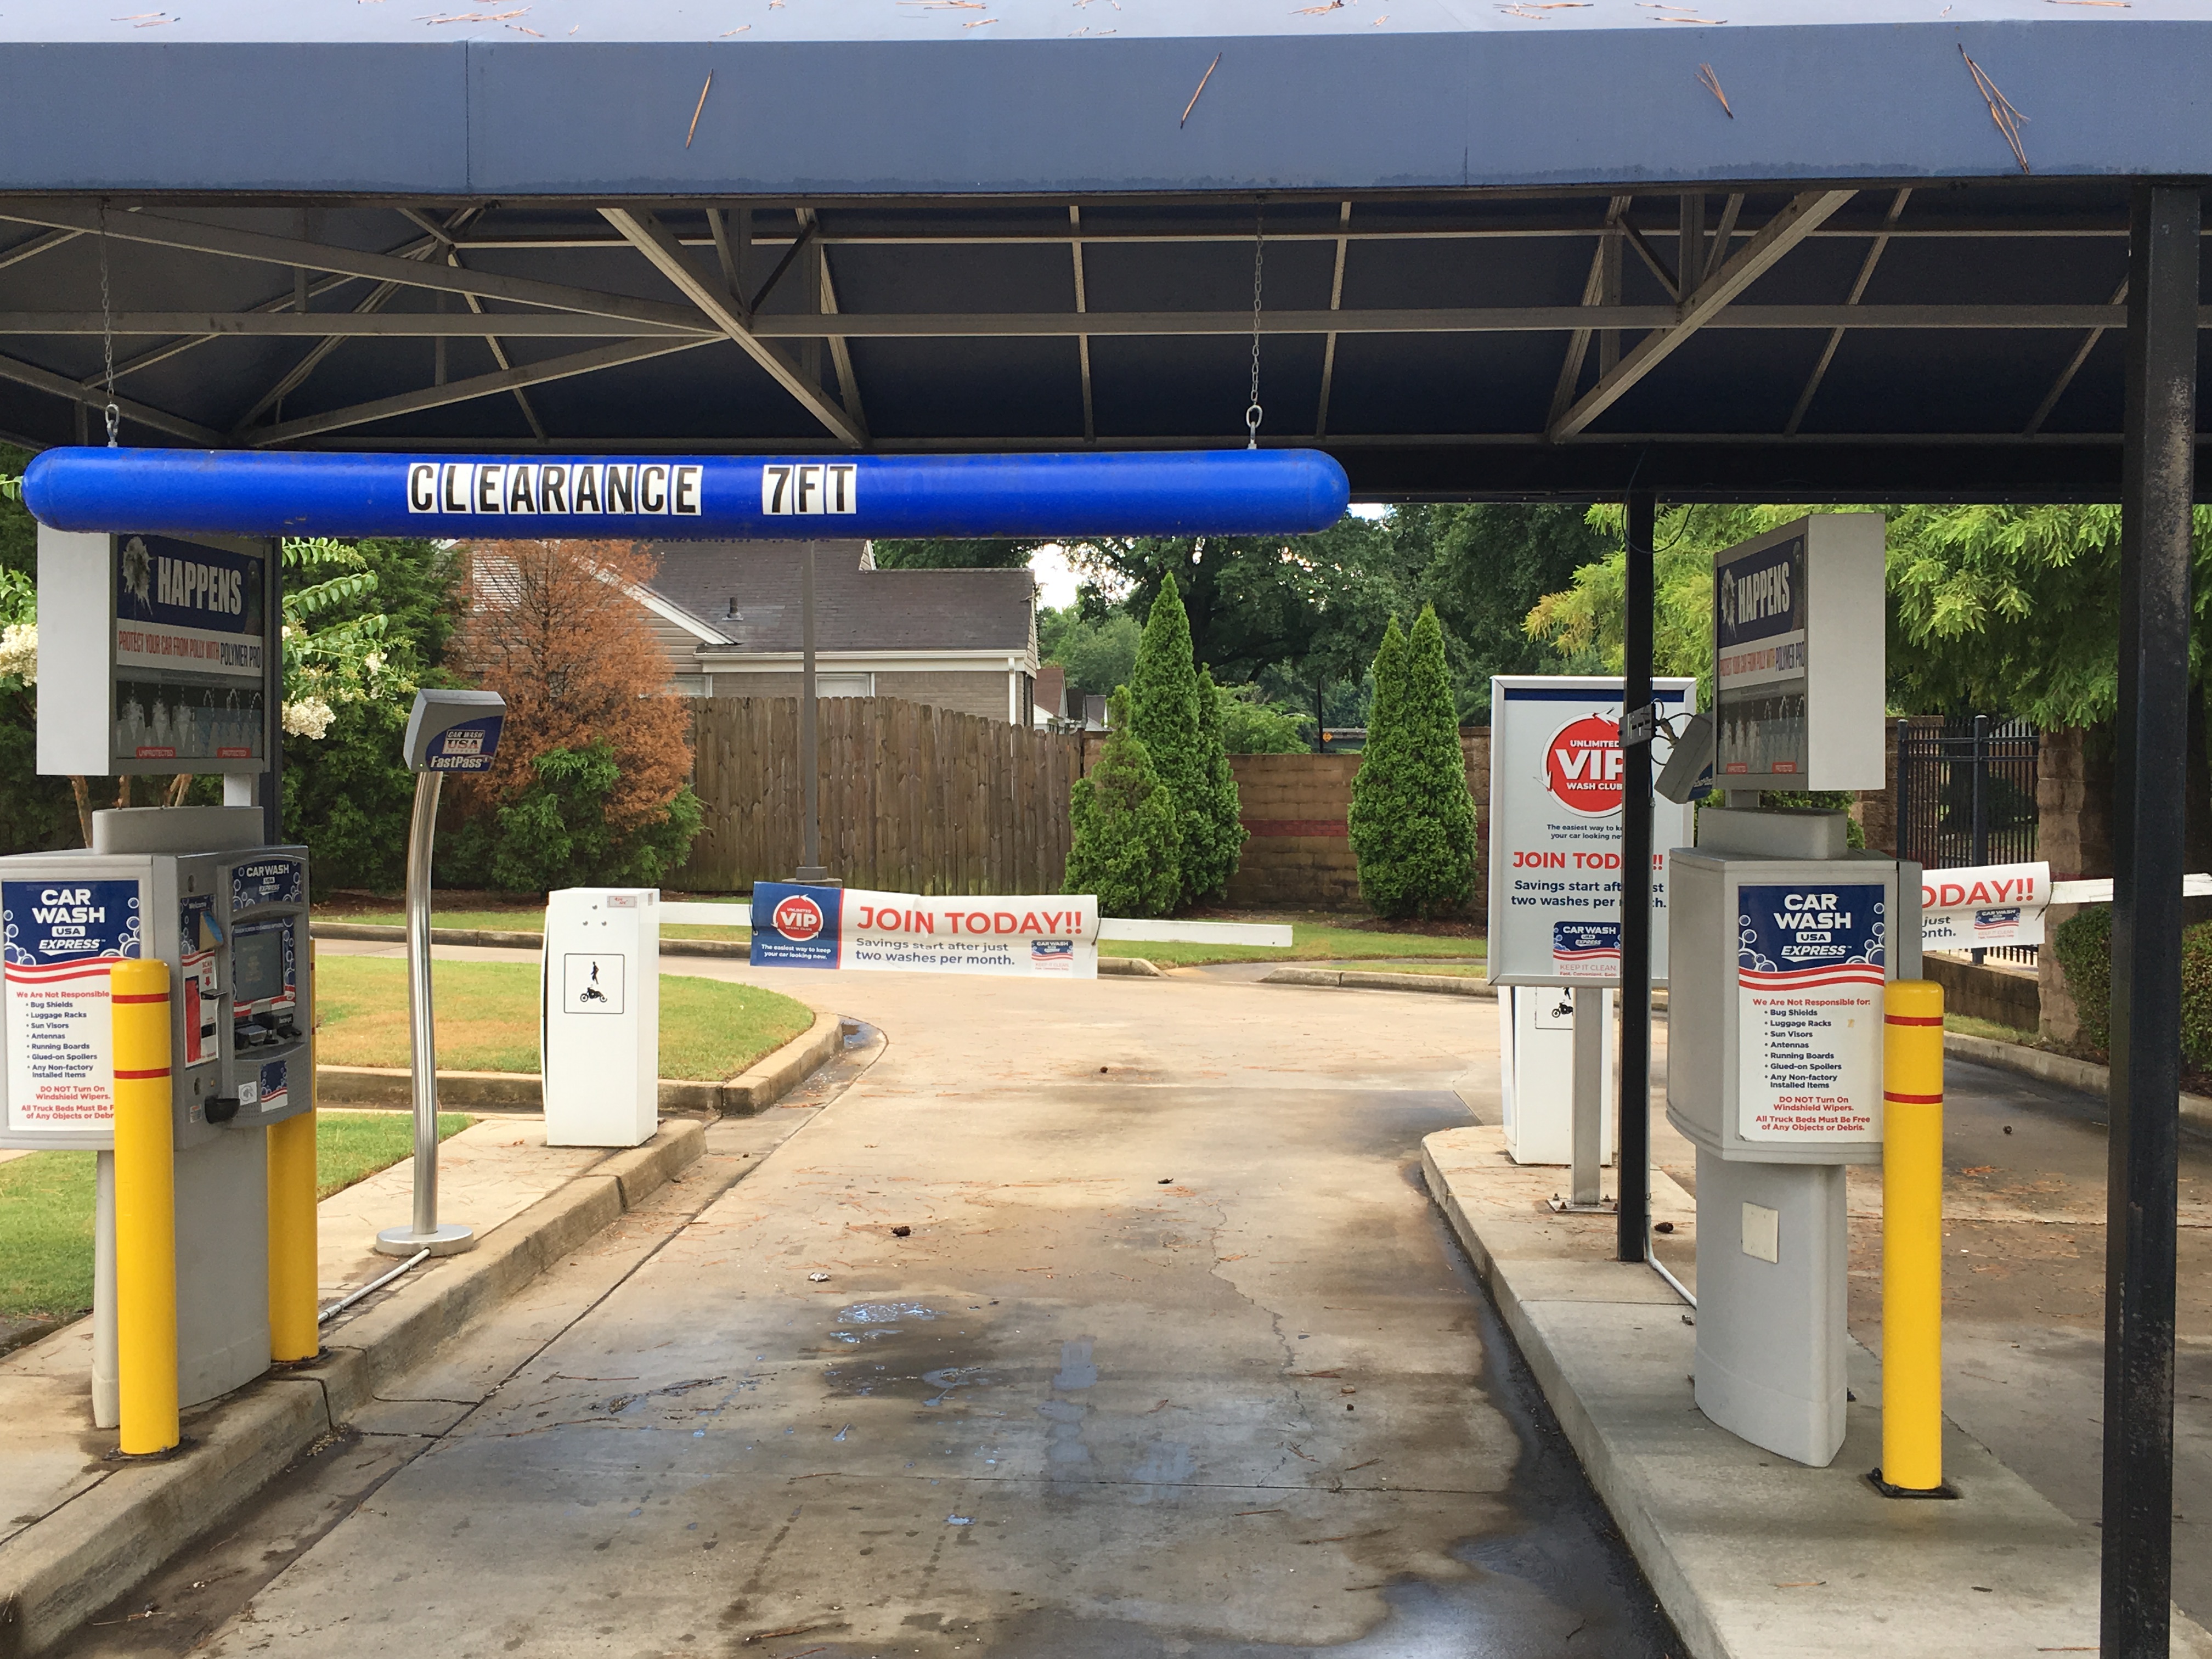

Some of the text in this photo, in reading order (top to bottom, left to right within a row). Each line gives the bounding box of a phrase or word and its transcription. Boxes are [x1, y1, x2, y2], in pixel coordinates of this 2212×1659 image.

[411, 465, 697, 513] CLEARANCE
[158, 556, 241, 615] HAPPENS
[1738, 562, 1790, 624] HAPPENS
[119, 630, 261, 668] PROTECT YOUR CAR FROM POLLY WITH POLYMER PRO
[448, 740, 478, 748] USA
[431, 755, 482, 768] FastPass
[1555, 749, 1623, 780] VIP
[1513, 851, 1565, 868] JOIN
[246, 864, 290, 877] CAR WASH
[1514, 880, 1600, 893] Savings start
[41, 889, 91, 905] CAR
[1511, 896, 1536, 905] two
[1540, 896, 1589, 906] washes
[1593, 898, 1615, 909] per
[1784, 894, 1837, 910] CAR
[32, 907, 105, 923] WASH
[780, 912, 817, 927] VIP
[857, 906, 1082, 934] JOIN TODAY!!
[1773, 912, 1851, 929] WASH
[1922, 916, 1951, 928] just
[38, 939, 100, 949] EXPRESS
[856, 938, 909, 950] Savings
[982, 943, 1008, 952] just
[1781, 946, 1847, 956] EXPRESS
[856, 950, 1015, 965] two washes per month.
